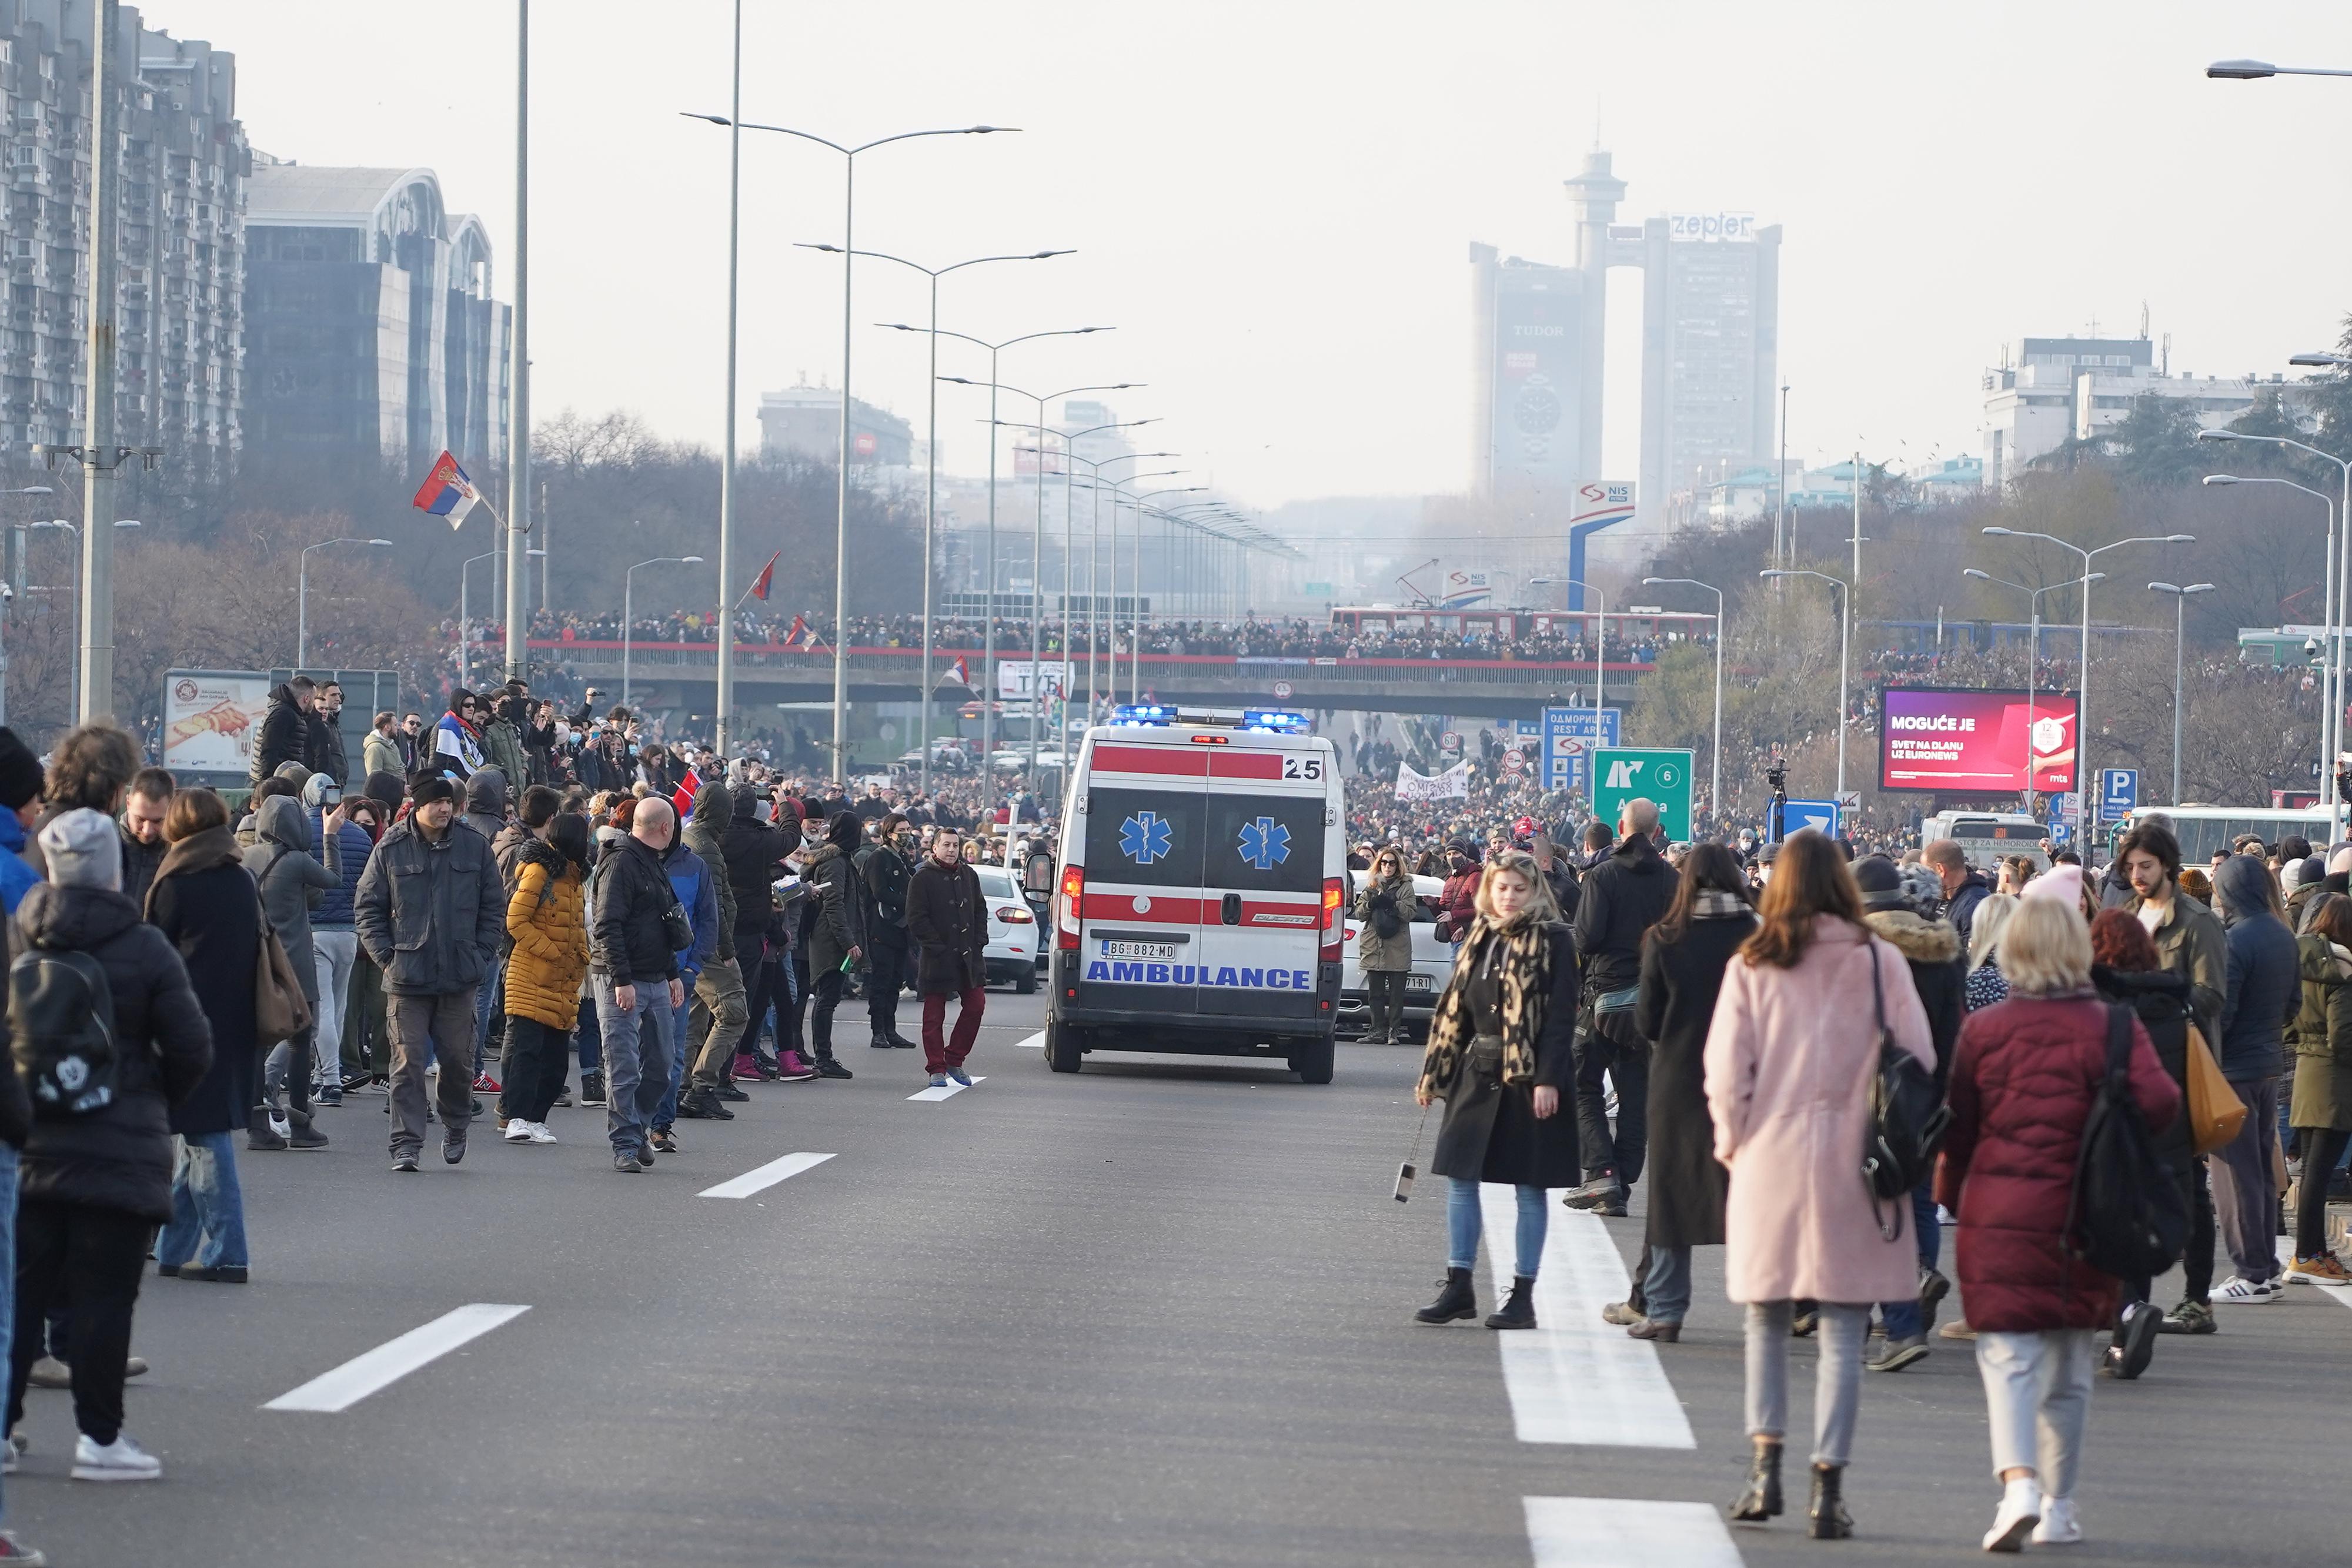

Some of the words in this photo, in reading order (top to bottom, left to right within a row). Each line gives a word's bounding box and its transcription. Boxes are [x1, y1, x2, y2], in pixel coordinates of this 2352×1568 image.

[1672, 212, 1754, 239] zepter
[1513, 325, 1564, 336] TUDOR
[1609, 486, 1628, 494] NIS
[1892, 714, 1957, 731] MOGUĆE
[1959, 718, 1975, 731] JE
[2043, 723, 2052, 731] 12
[1553, 725, 1577, 734] REST
[1583, 726, 1609, 734] ARA
[1444, 735, 1455, 745] 60
[1891, 740, 1916, 750] SVET
[1916, 741, 1930, 750] NA
[1931, 741, 1964, 751] DLANU
[1891, 750, 1905, 760] UZ
[1905, 750, 1959, 761] EURONEWS
[1285, 759, 1321, 780] 25
[1663, 771, 1671, 781] 6
[2049, 774, 2068, 783] mts
[2112, 771, 2130, 796] P
[1994, 827, 2006, 838] 601
[2053, 824, 2065, 844] P
[1111, 943, 1124, 954] BG
[1086, 961, 1310, 990] AMBULANCE
[479, 1079, 493, 1090] N
